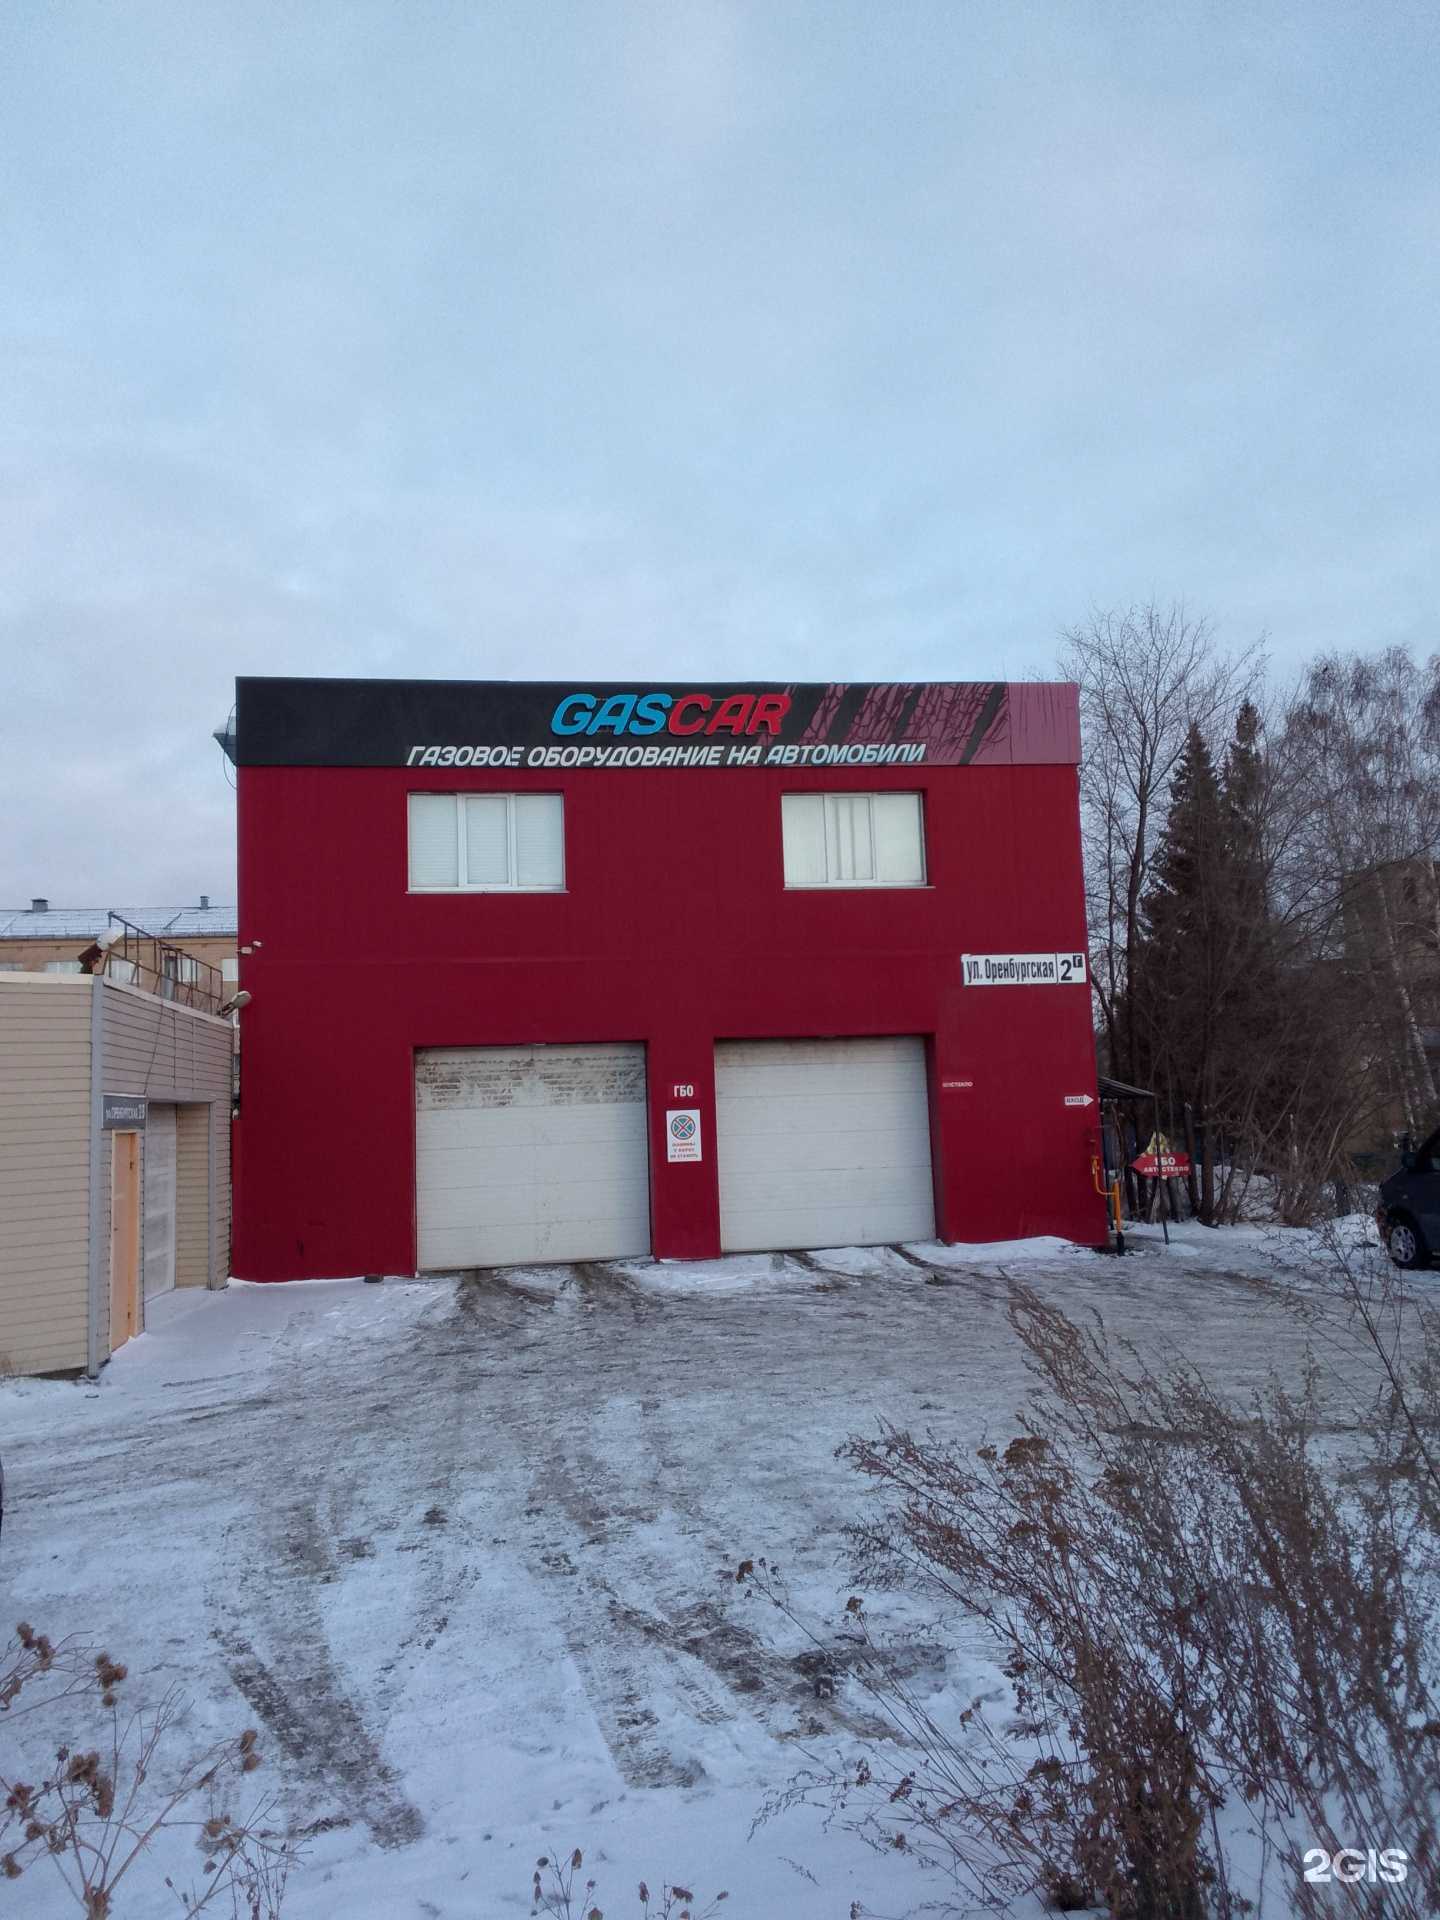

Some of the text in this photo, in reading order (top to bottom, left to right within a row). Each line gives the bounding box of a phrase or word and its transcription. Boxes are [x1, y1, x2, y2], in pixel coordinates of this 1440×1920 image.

[551, 693, 791, 736] GASCAR
[406, 743, 926, 767] ГАЗОВОЕ ОБОРУДОВАНИЕ НА АВТОМОБИЛИ
[966, 960, 983, 983] ул.
[985, 958, 1055, 983] Оренбургская
[673, 1085, 694, 1097] ГБО
